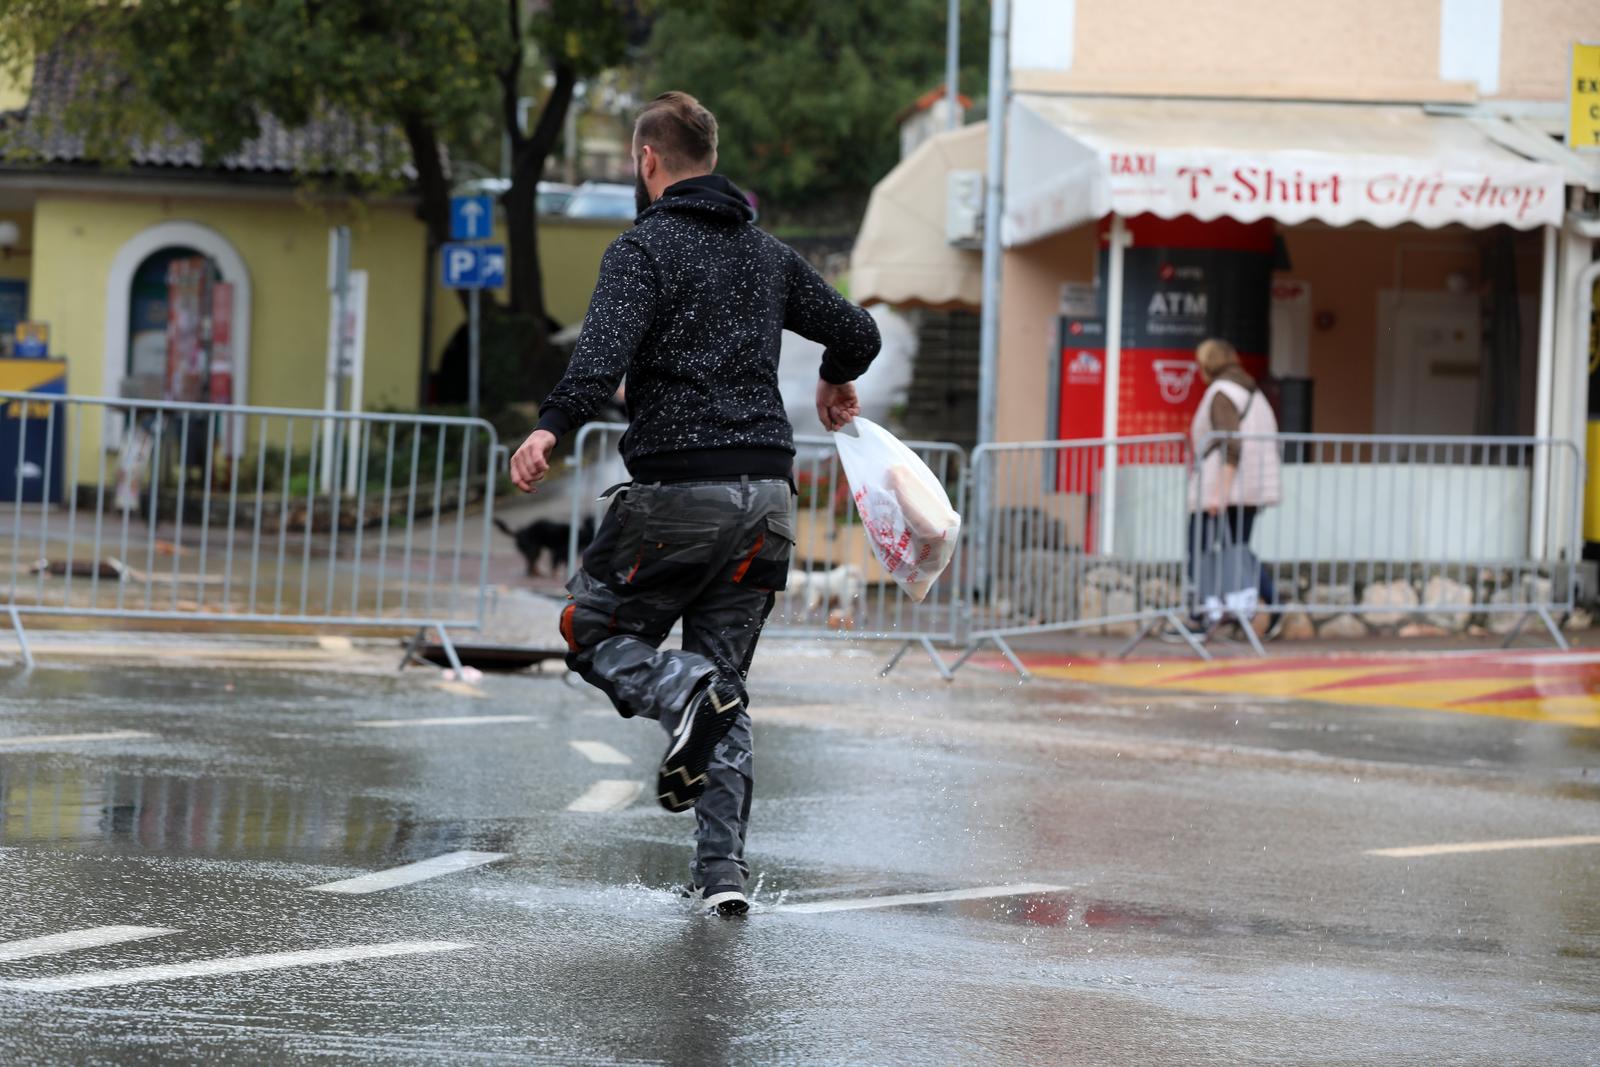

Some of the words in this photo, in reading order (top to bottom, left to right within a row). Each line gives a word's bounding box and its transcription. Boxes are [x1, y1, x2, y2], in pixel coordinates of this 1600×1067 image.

[1111, 153, 1156, 175] TAXI
[1177, 167, 1340, 204] T-Shirt
[1366, 172, 1444, 213] Gift
[1456, 175, 1546, 221] shop
[450, 249, 475, 281] P
[1148, 292, 1207, 316] ATM
